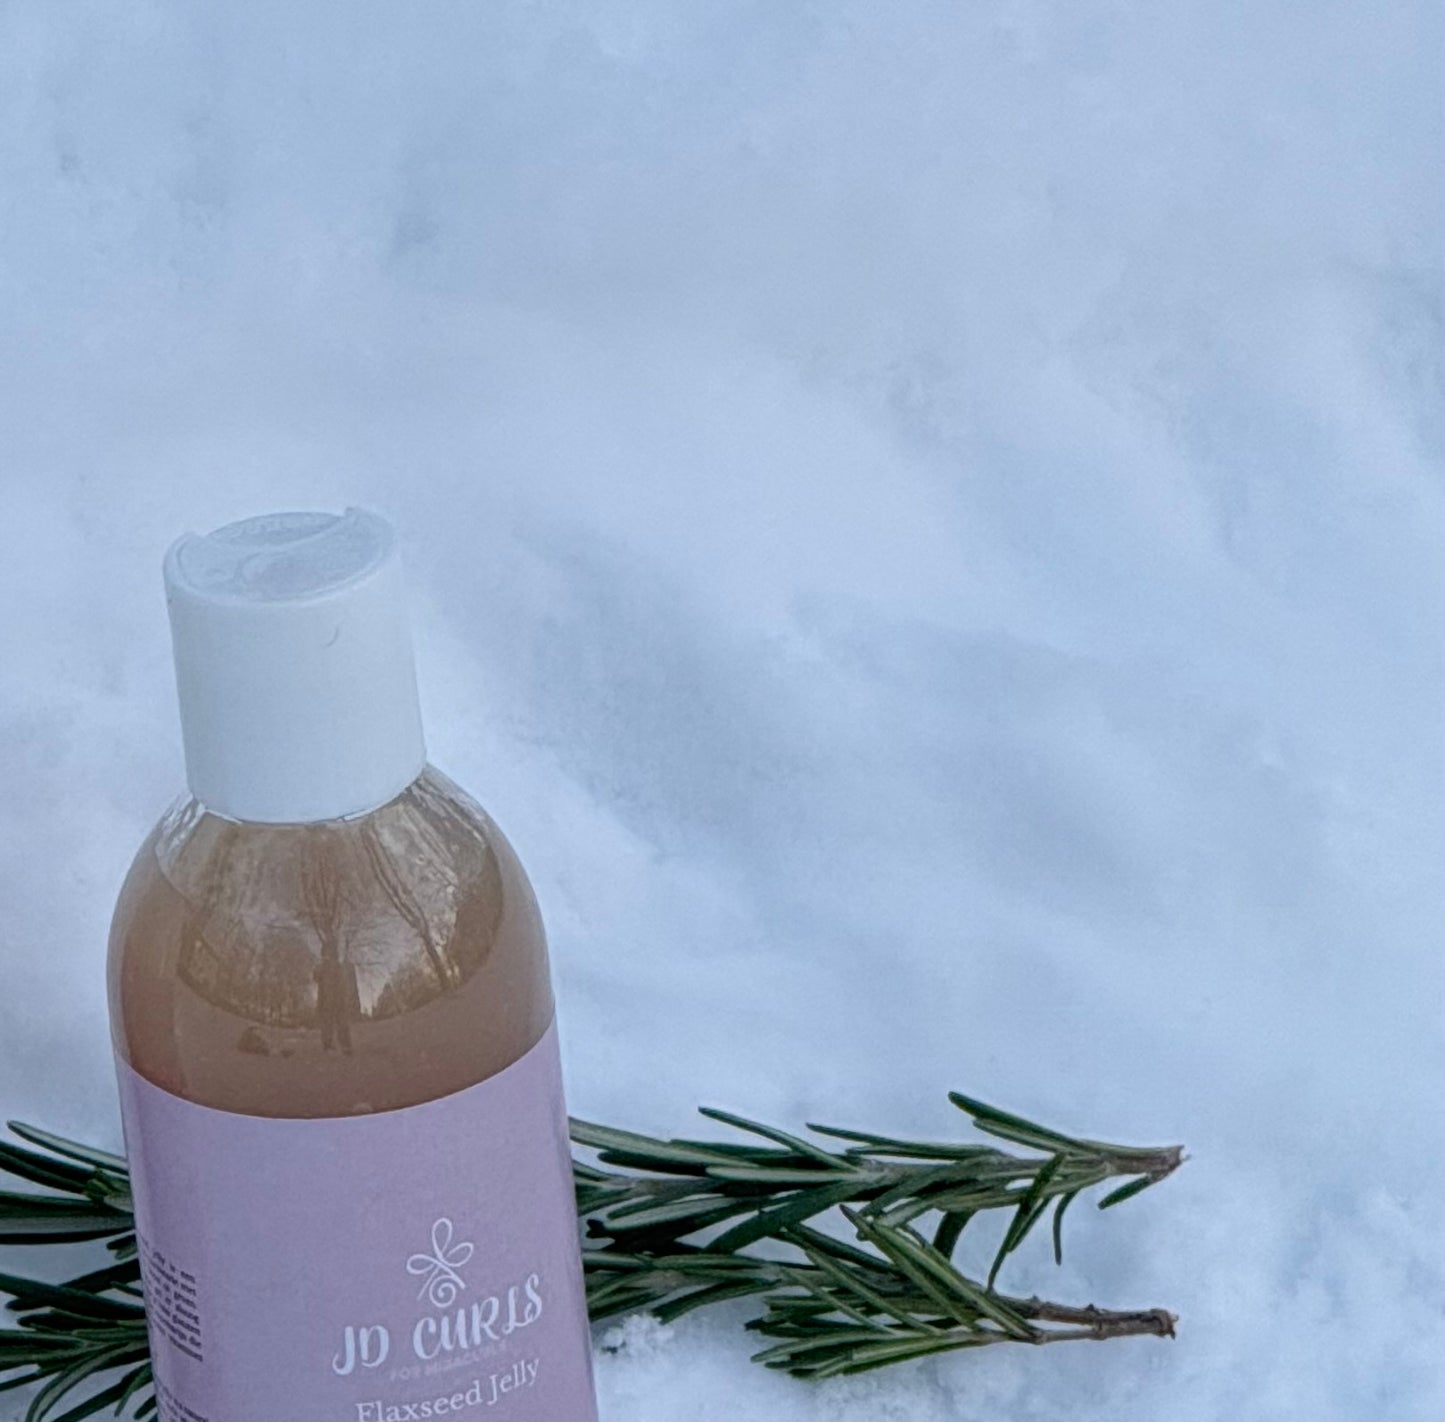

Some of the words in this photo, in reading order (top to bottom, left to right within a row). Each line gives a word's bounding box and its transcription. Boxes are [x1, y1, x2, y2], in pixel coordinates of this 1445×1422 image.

[332, 1325, 390, 1376] JD
[412, 1272, 543, 1360] CURLS
[487, 1357, 540, 1406] Jelly
